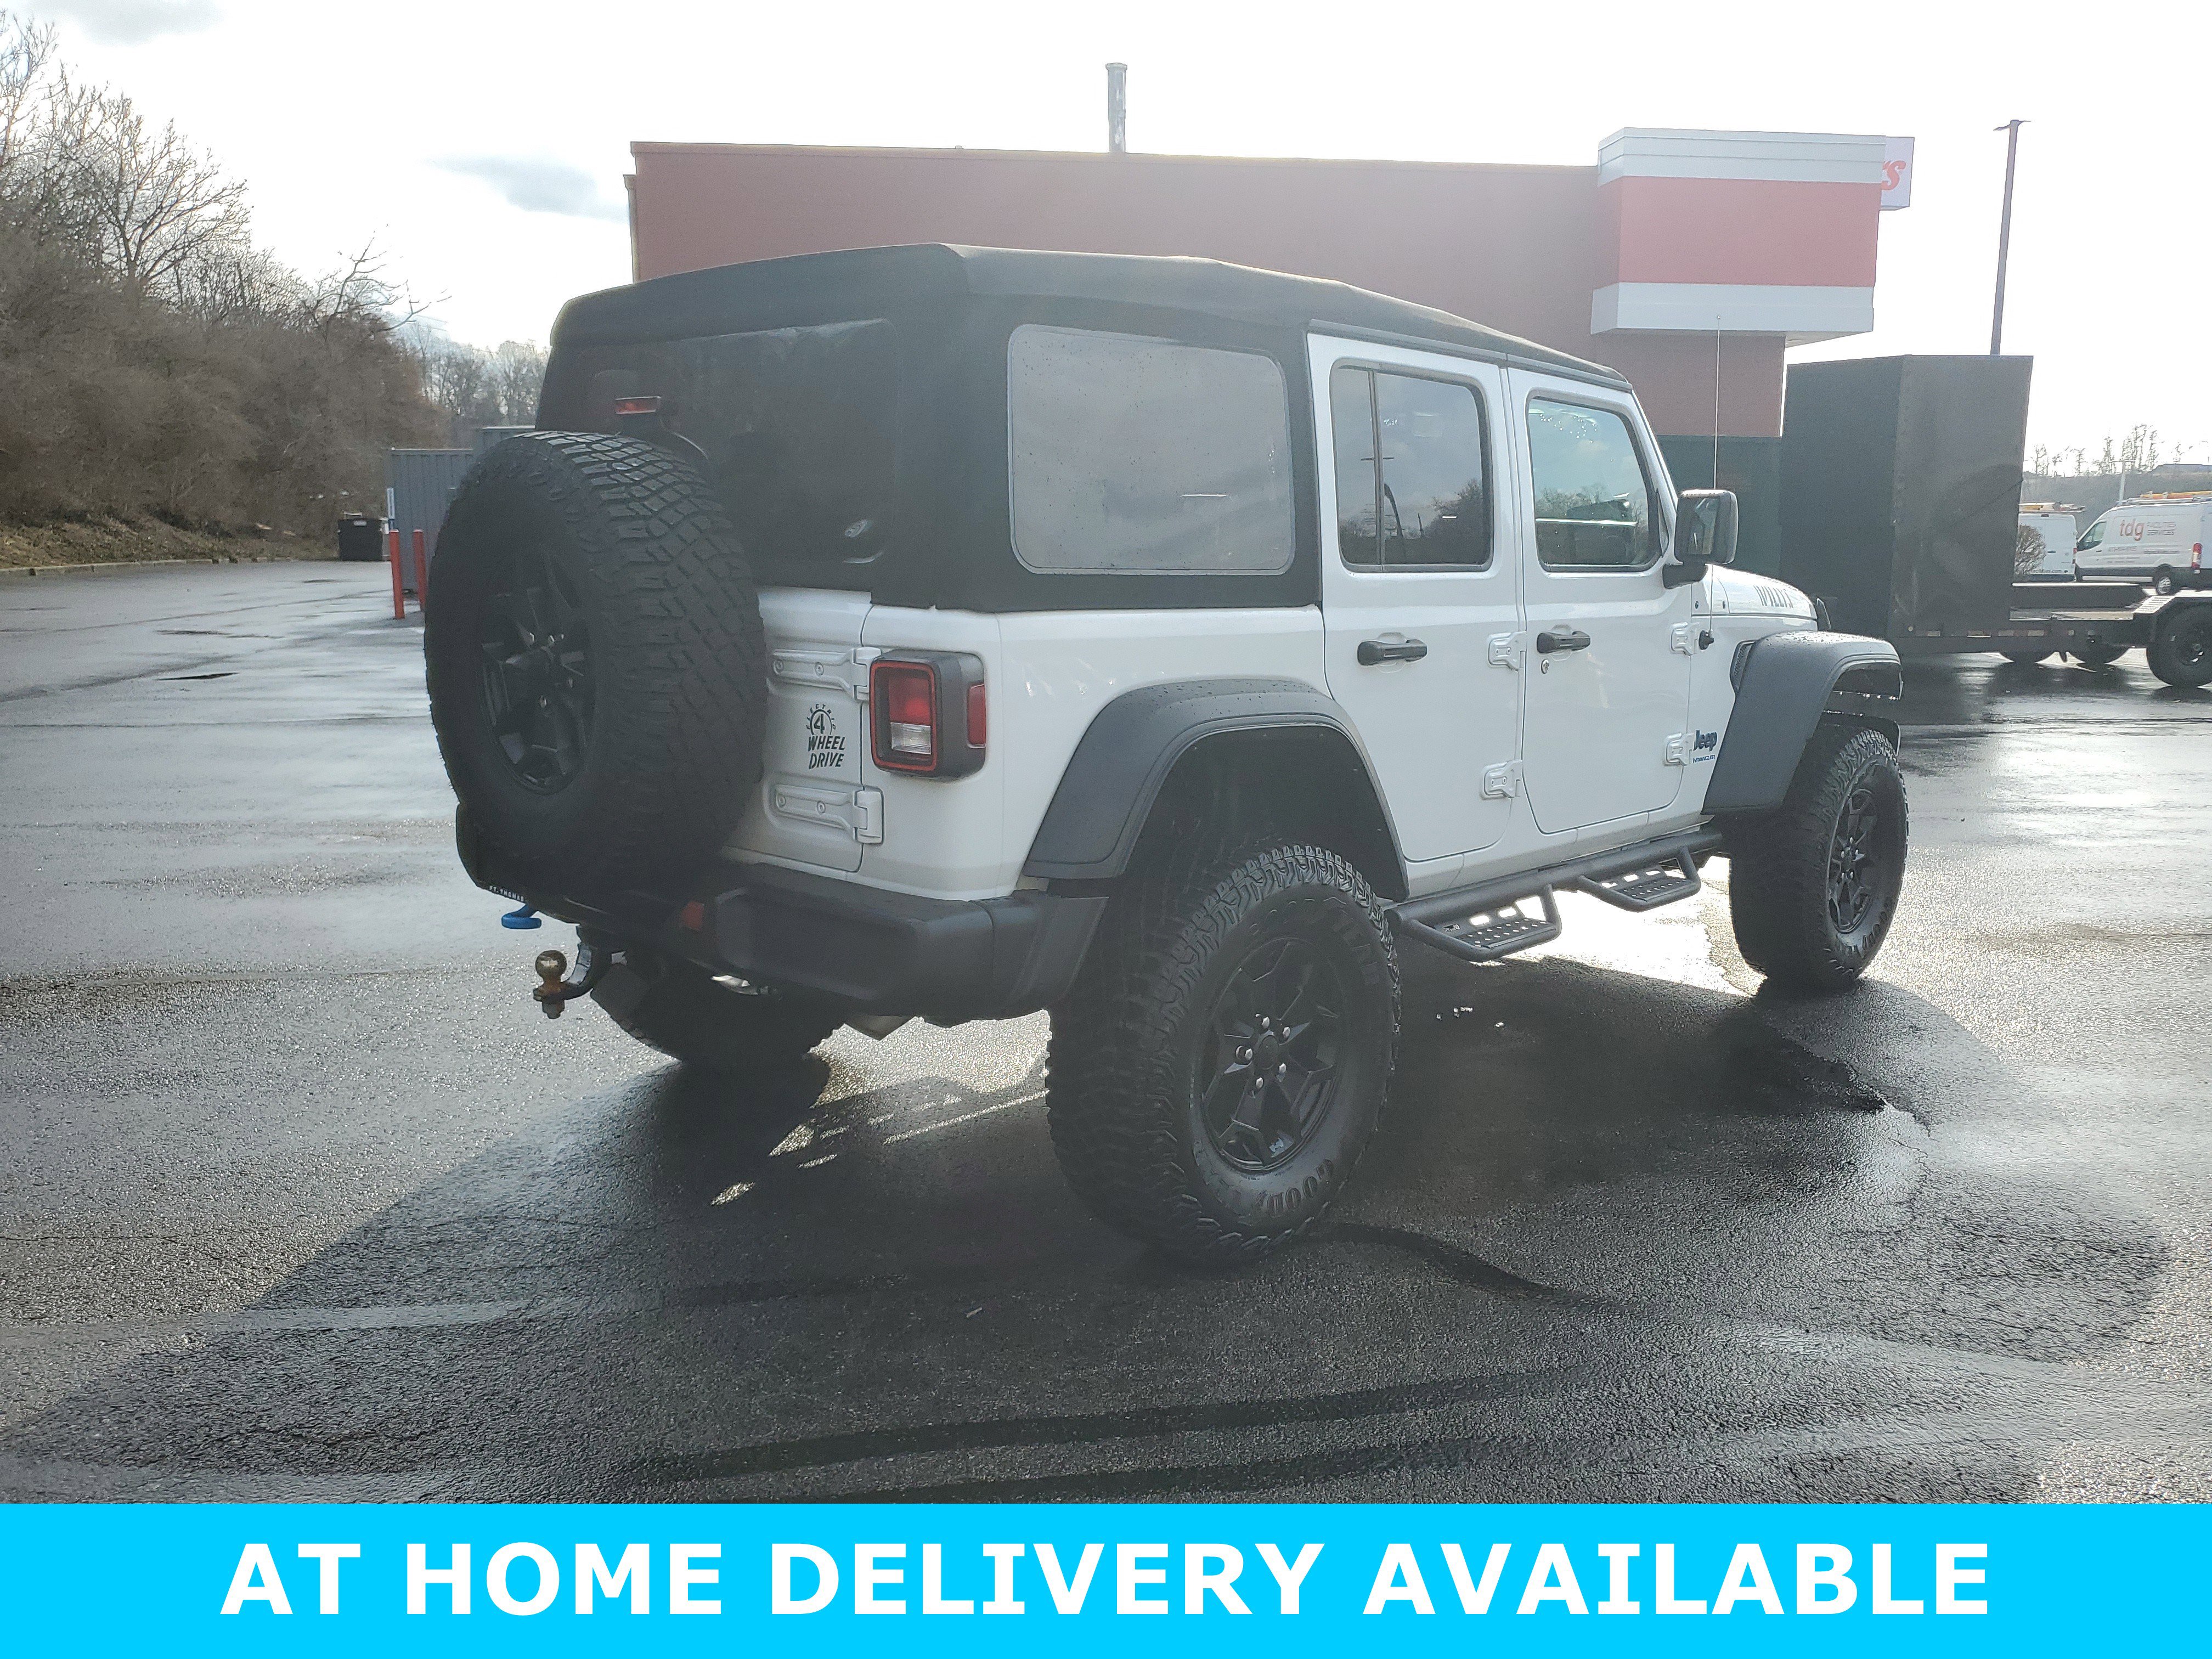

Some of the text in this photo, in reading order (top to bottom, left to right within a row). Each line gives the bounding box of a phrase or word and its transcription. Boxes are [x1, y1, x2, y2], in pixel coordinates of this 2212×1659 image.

[2120, 518, 2145, 541] tdg
[814, 713, 825, 734] 4
[808, 736, 845, 752] WHEEL
[1694, 730, 1717, 752] Jeep
[809, 752, 844, 769] DRIVE
